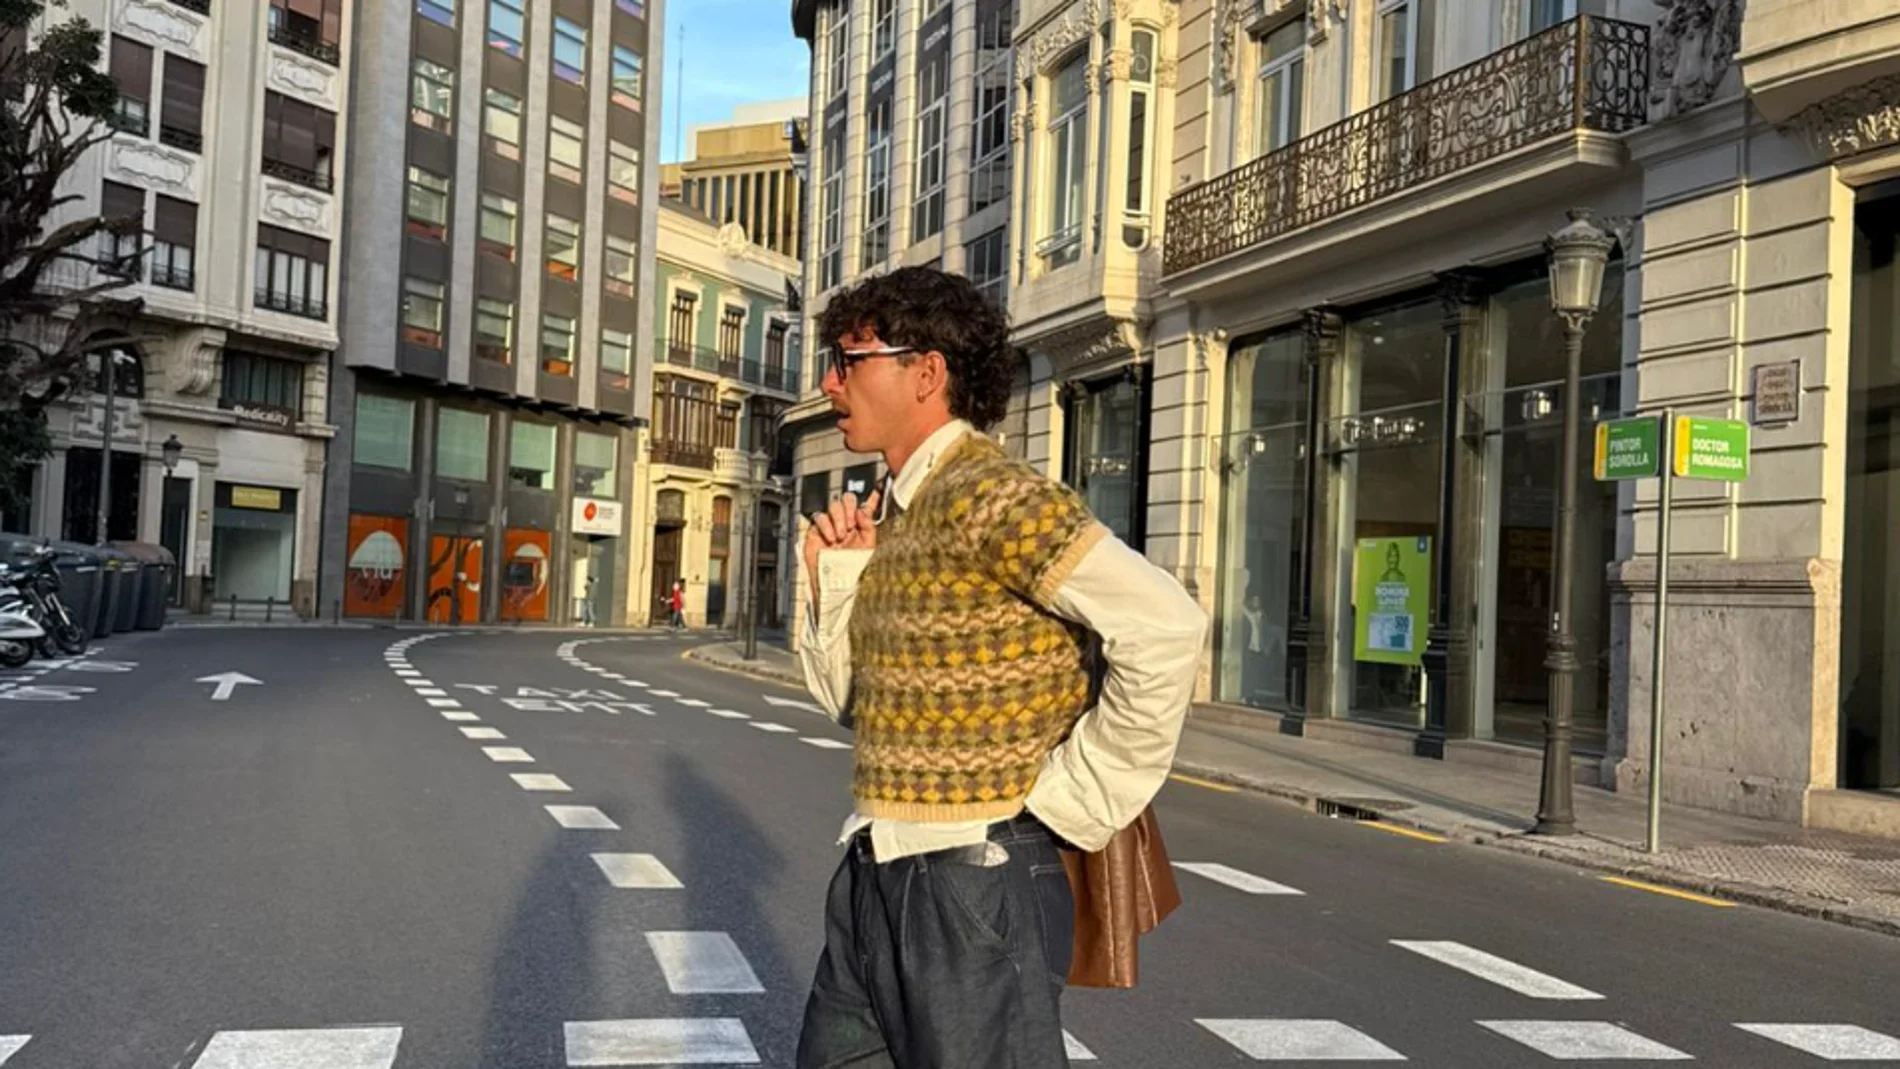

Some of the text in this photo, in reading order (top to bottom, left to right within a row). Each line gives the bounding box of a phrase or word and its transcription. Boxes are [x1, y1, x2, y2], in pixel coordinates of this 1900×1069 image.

[1609, 437, 1642, 453] PINTOR
[1692, 437, 1730, 453] DOCTOR
[1609, 452, 1650, 469] SOROLLA
[1691, 452, 1744, 470] ROMAGOSA
